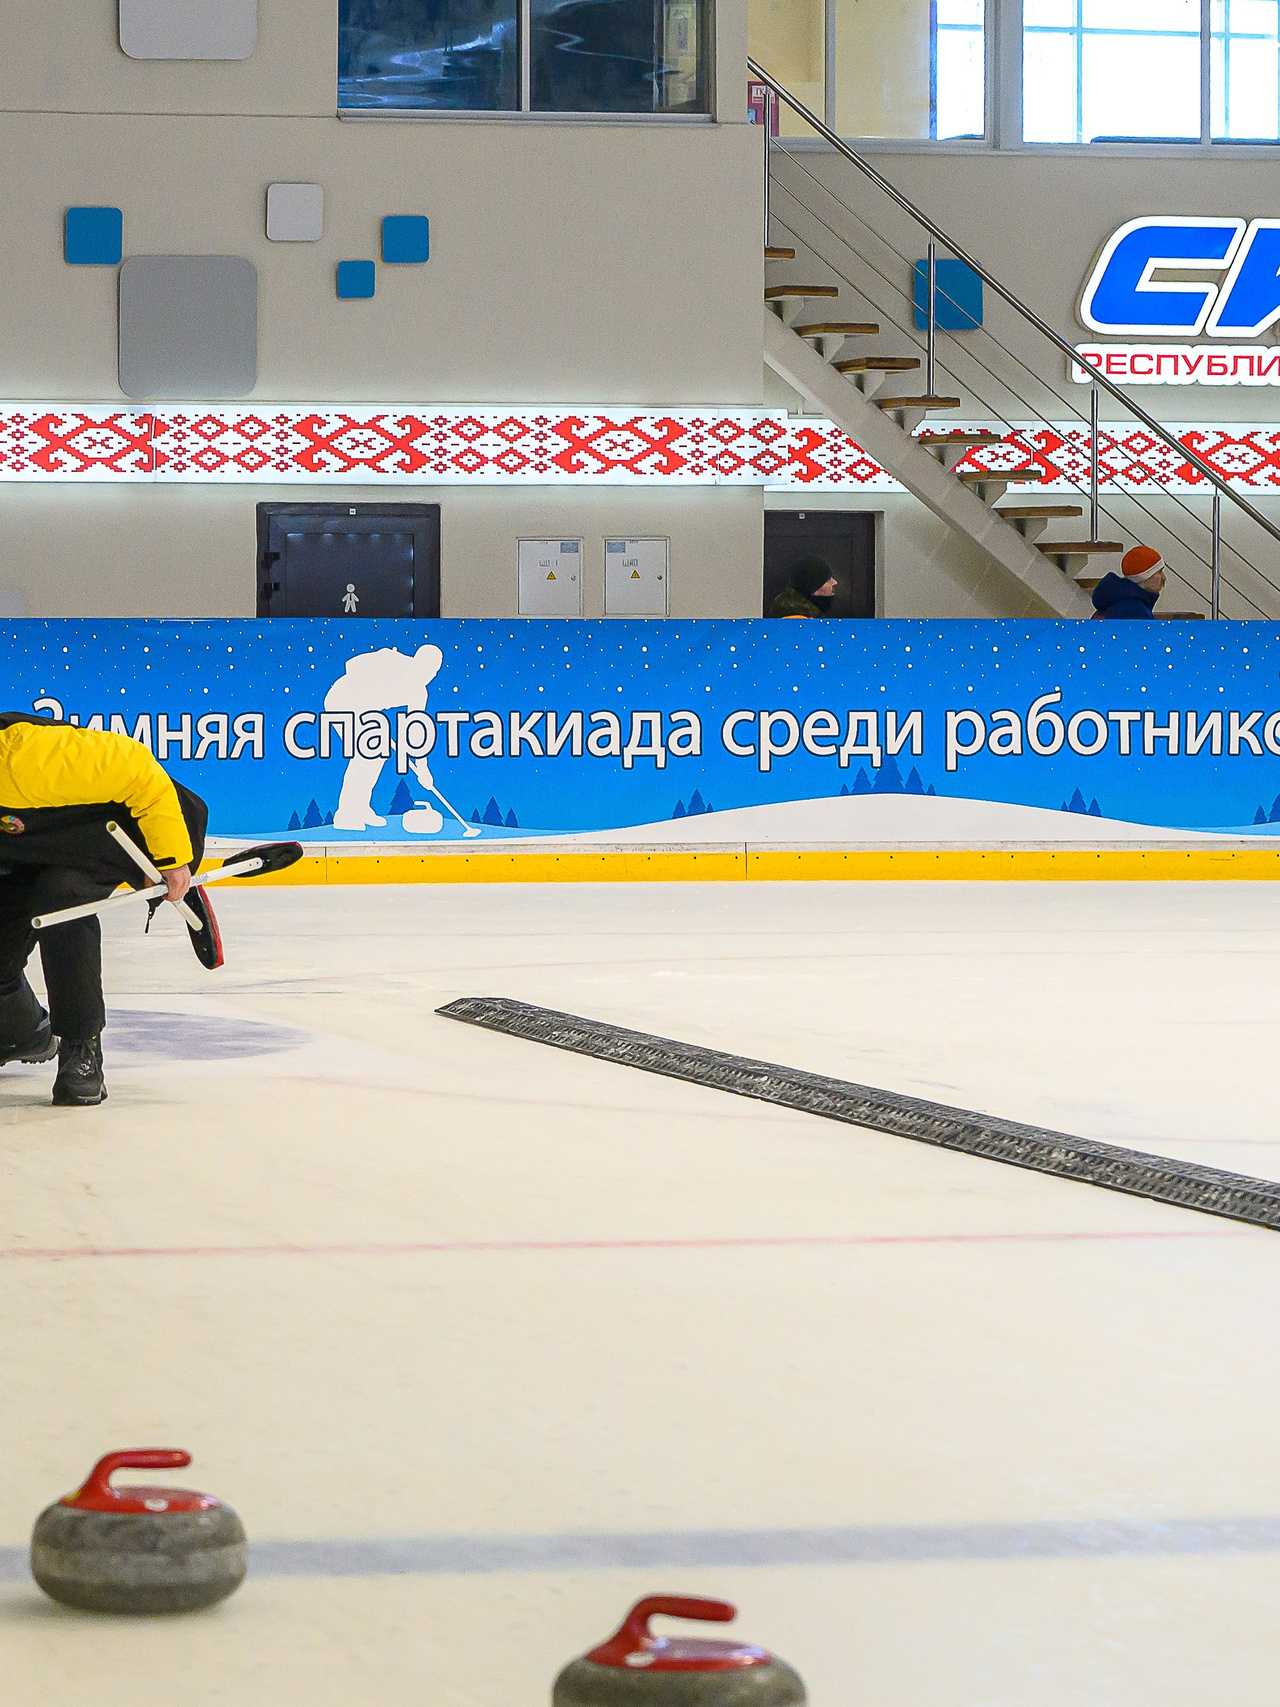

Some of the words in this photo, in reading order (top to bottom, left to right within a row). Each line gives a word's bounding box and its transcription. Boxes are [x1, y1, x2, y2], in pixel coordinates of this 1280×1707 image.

[1081, 353, 1280, 376] РЕСПУБЛИ
[33, 697, 266, 760] мняя
[283, 709, 702, 774] спартакиада
[722, 709, 923, 772] среди
